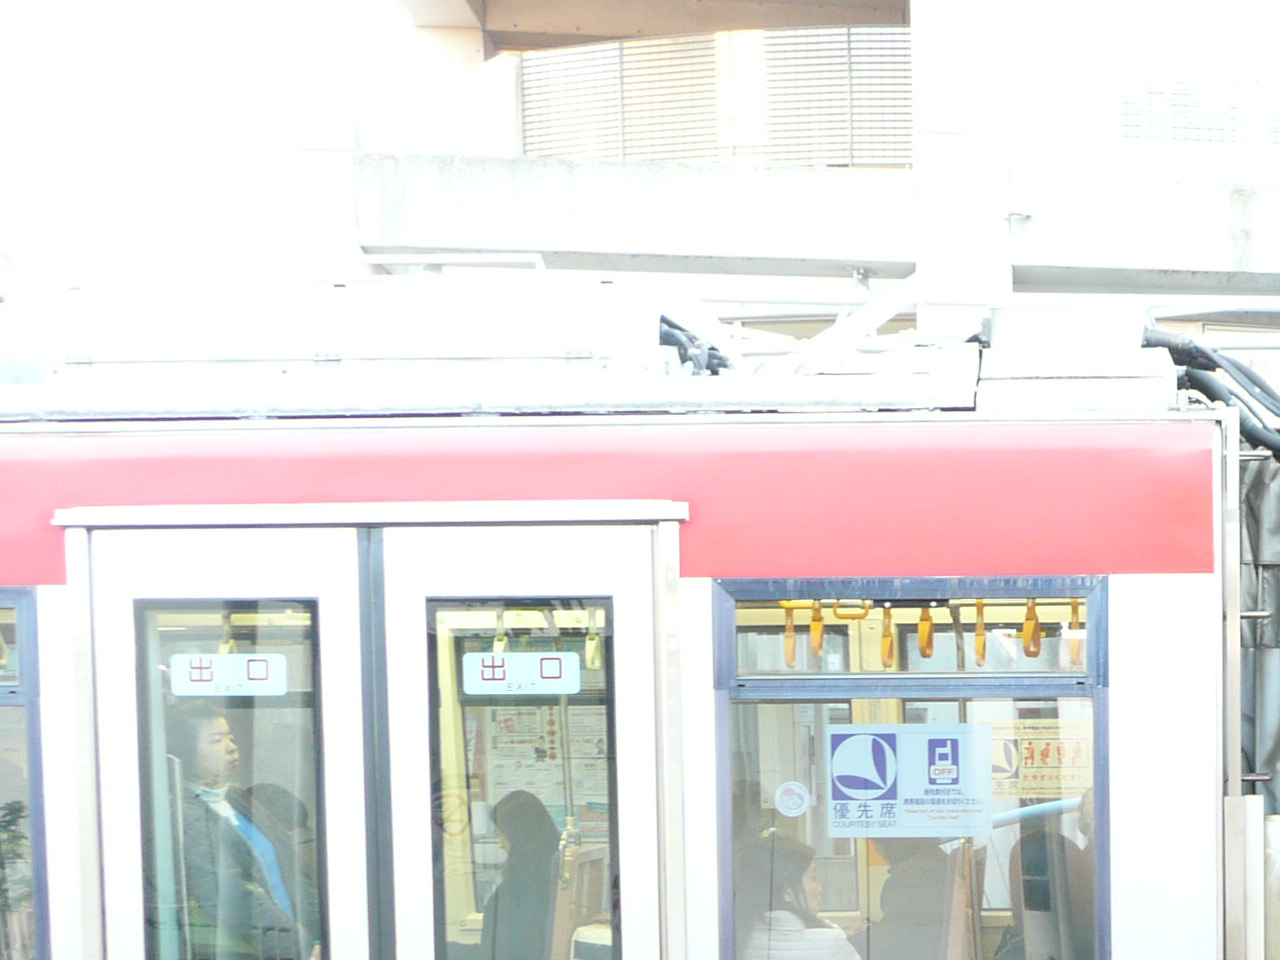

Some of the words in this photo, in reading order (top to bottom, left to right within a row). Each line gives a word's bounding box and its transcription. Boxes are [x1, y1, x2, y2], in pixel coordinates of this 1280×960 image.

[189, 657, 269, 682] 出口
[481, 656, 562, 681] 出口
[507, 683, 536, 692] EXIT
[933, 768, 955, 776] OFF
[832, 802, 897, 820] 優先席
[877, 820, 897, 828] SEAT
